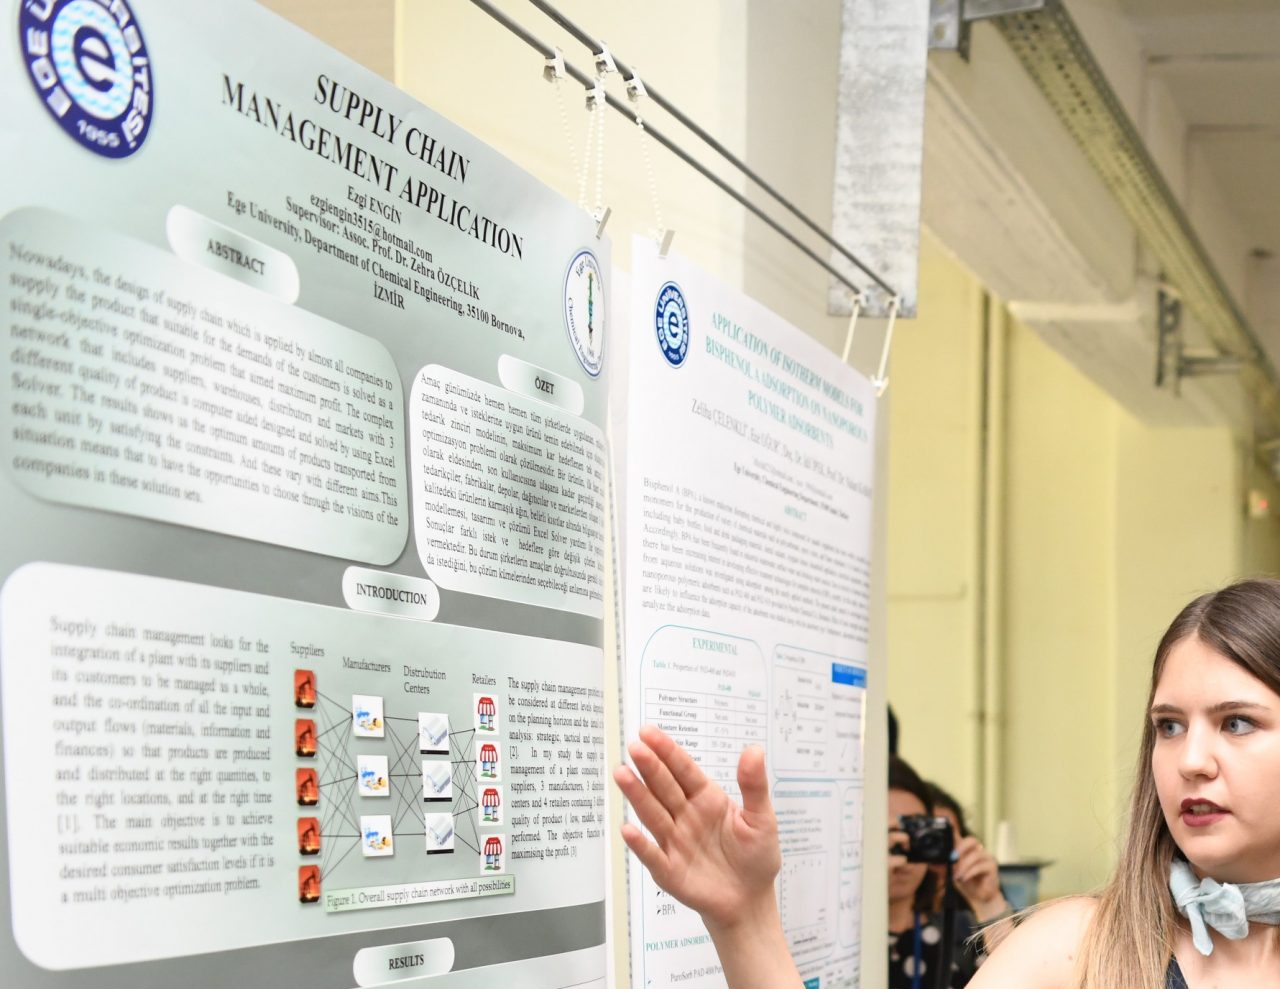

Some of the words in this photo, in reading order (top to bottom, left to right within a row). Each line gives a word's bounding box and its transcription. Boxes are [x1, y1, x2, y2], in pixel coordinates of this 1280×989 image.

[314, 74, 402, 145] SUPPLY
[405, 127, 470, 183] CHAIN
[222, 73, 398, 193] MANAGEMENT
[399, 176, 523, 260] APPLICATION
[347, 185, 367, 207] Ezgi
[369, 199, 402, 225] ENGİN
[310, 193, 433, 262] ezgiengin3515@hotmail.com
[207, 239, 265, 275] ABSTRACT
[286, 196, 340, 233] Supervisor:
[342, 226, 369, 249] Assoc.
[372, 239, 393, 260] Prof.
[395, 251, 408, 267] Dr.
[410, 257, 435, 280] Zehra
[437, 267, 480, 300] ÖZÇELİK
[227, 191, 246, 215] Ege
[250, 201, 302, 241] University,
[304, 228, 359, 266] Department
[361, 252, 370, 272] of
[372, 260, 412, 290] Chemical
[414, 282, 465, 316] Engineering,
[467, 302, 488, 325] 35100
[491, 313, 525, 340] Bornova,
[374, 281, 405, 309] İZMİR
[535, 376, 555, 394] ÖZET
[356, 582, 427, 606] INTRODUCTION
[290, 641, 325, 658] Suppliers
[343, 656, 391, 674] Manufacturers
[404, 682, 430, 695] Centers
[472, 672, 497, 686] Retailers
[508, 677, 519, 689] The
[521, 680, 539, 692] supply
[542, 681, 556, 693] chain
[509, 695, 515, 706] be
[518, 696, 548, 708] considered
[532, 797, 542, 808] and
[359, 889, 385, 904] Overall
[387, 888, 409, 903] supply
[411, 885, 428, 899] chain
[429, 883, 455, 897] network
[456, 881, 470, 895] with
[470, 881, 478, 892] all
[479, 878, 511, 893] possibilities
[680, 935, 711, 948] ADSORBEN
[389, 954, 425, 970] RESULTS
